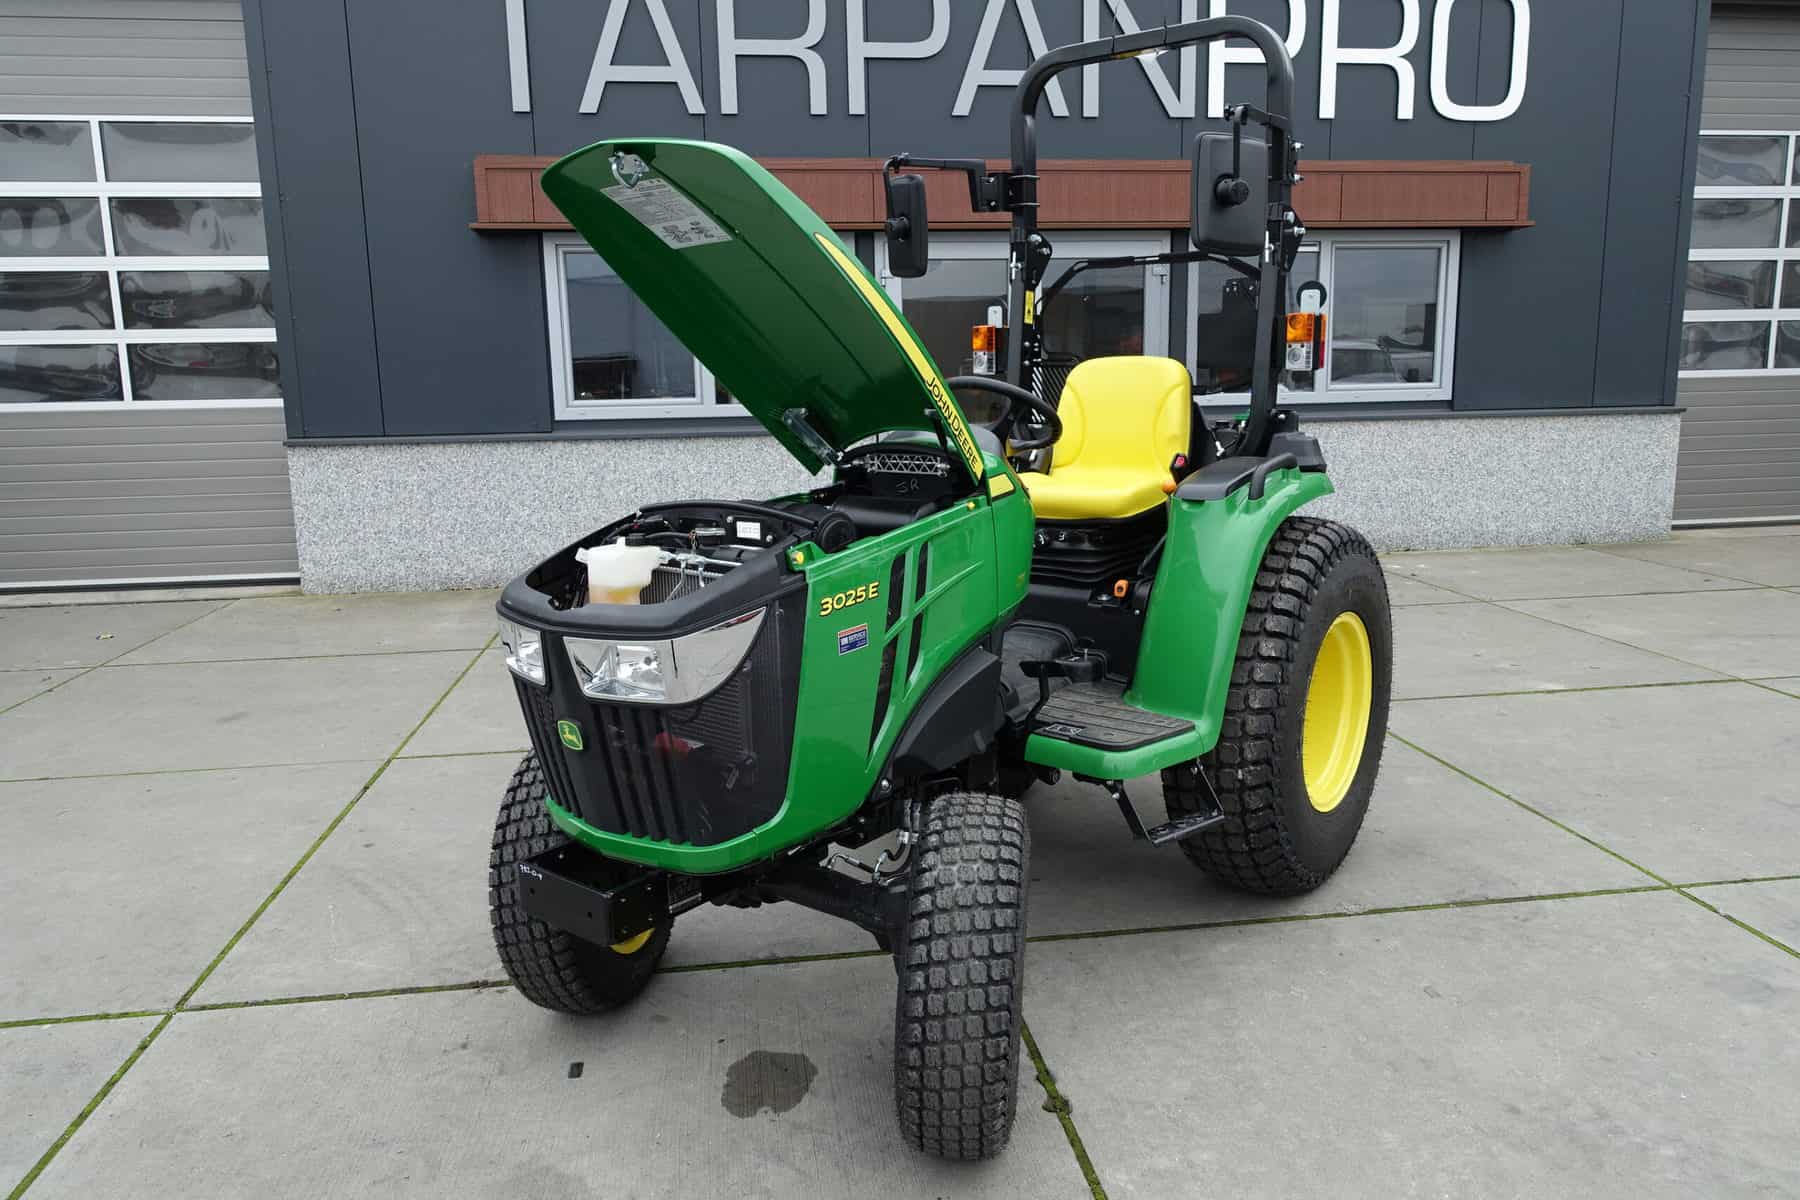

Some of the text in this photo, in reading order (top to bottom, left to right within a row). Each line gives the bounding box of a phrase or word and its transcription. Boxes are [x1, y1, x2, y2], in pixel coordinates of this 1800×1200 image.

[926, 377, 978, 470] JOHN DEERE
[819, 581, 880, 617] 3025E
